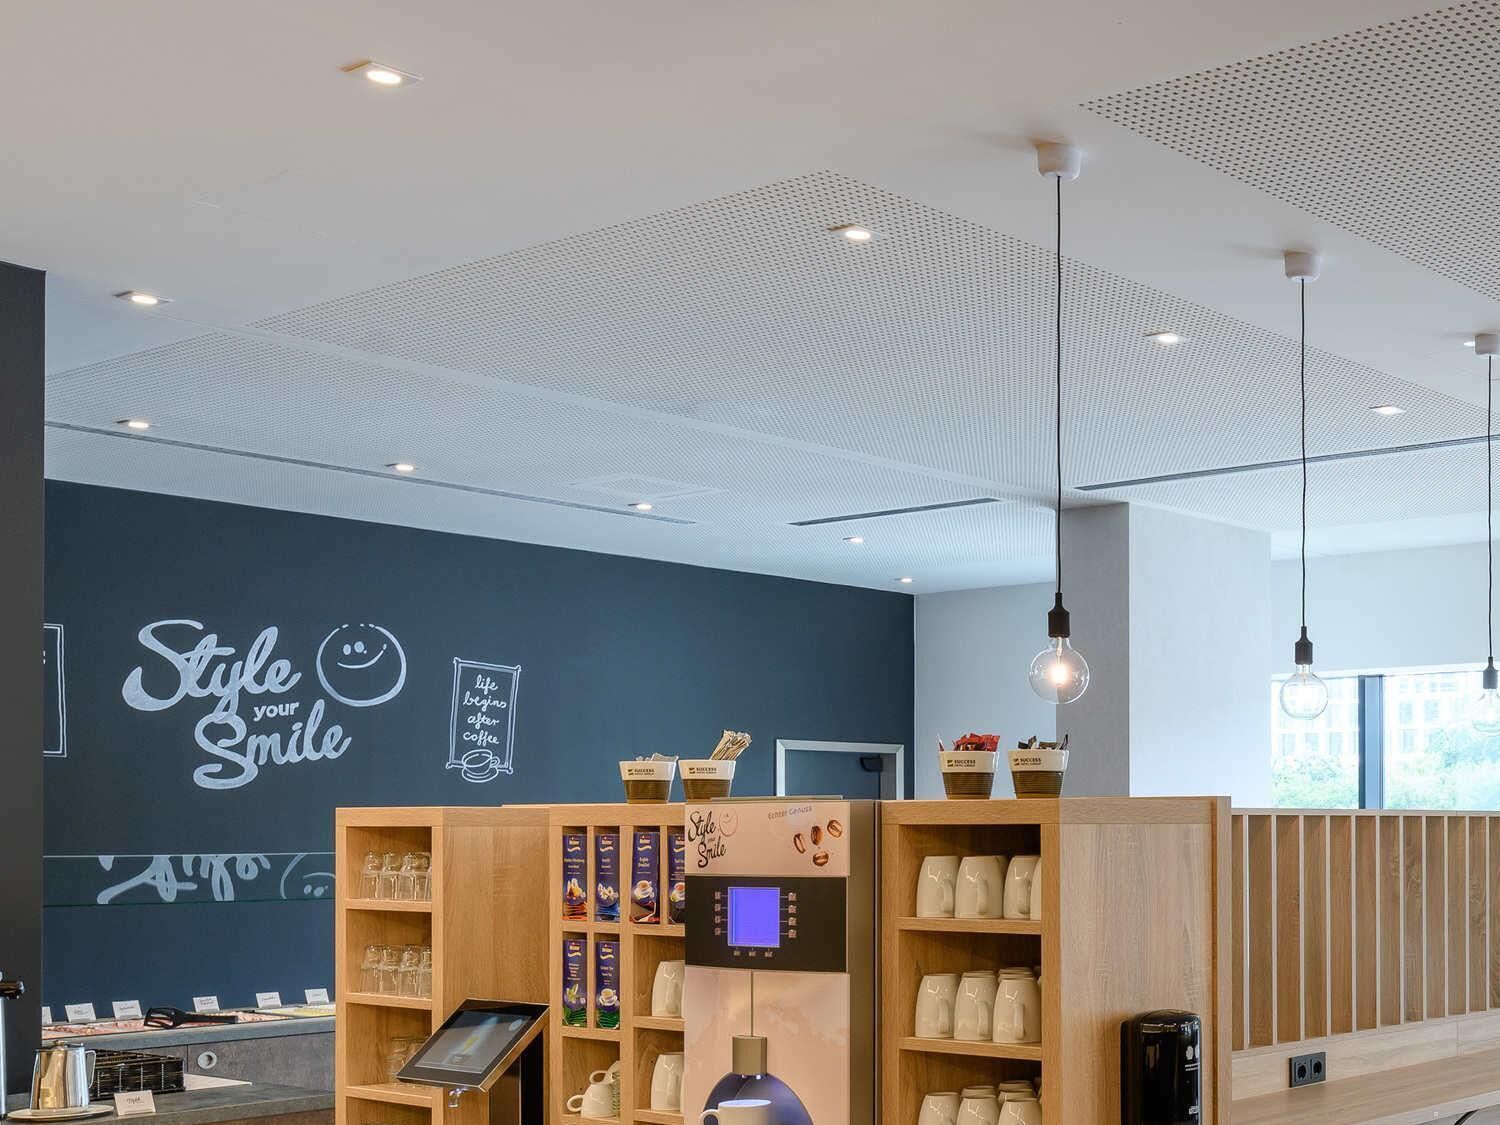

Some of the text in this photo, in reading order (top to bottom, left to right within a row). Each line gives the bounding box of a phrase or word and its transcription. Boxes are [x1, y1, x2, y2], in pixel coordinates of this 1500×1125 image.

[122, 619, 302, 723] Style
[475, 674, 498, 695] life
[253, 701, 300, 722] your
[463, 691, 507, 712] begins
[467, 712, 499, 730] after
[193, 699, 352, 790] Smile
[463, 730, 499, 747] coffee
[688, 810, 717, 843] Style
[697, 835, 727, 868] Smile
